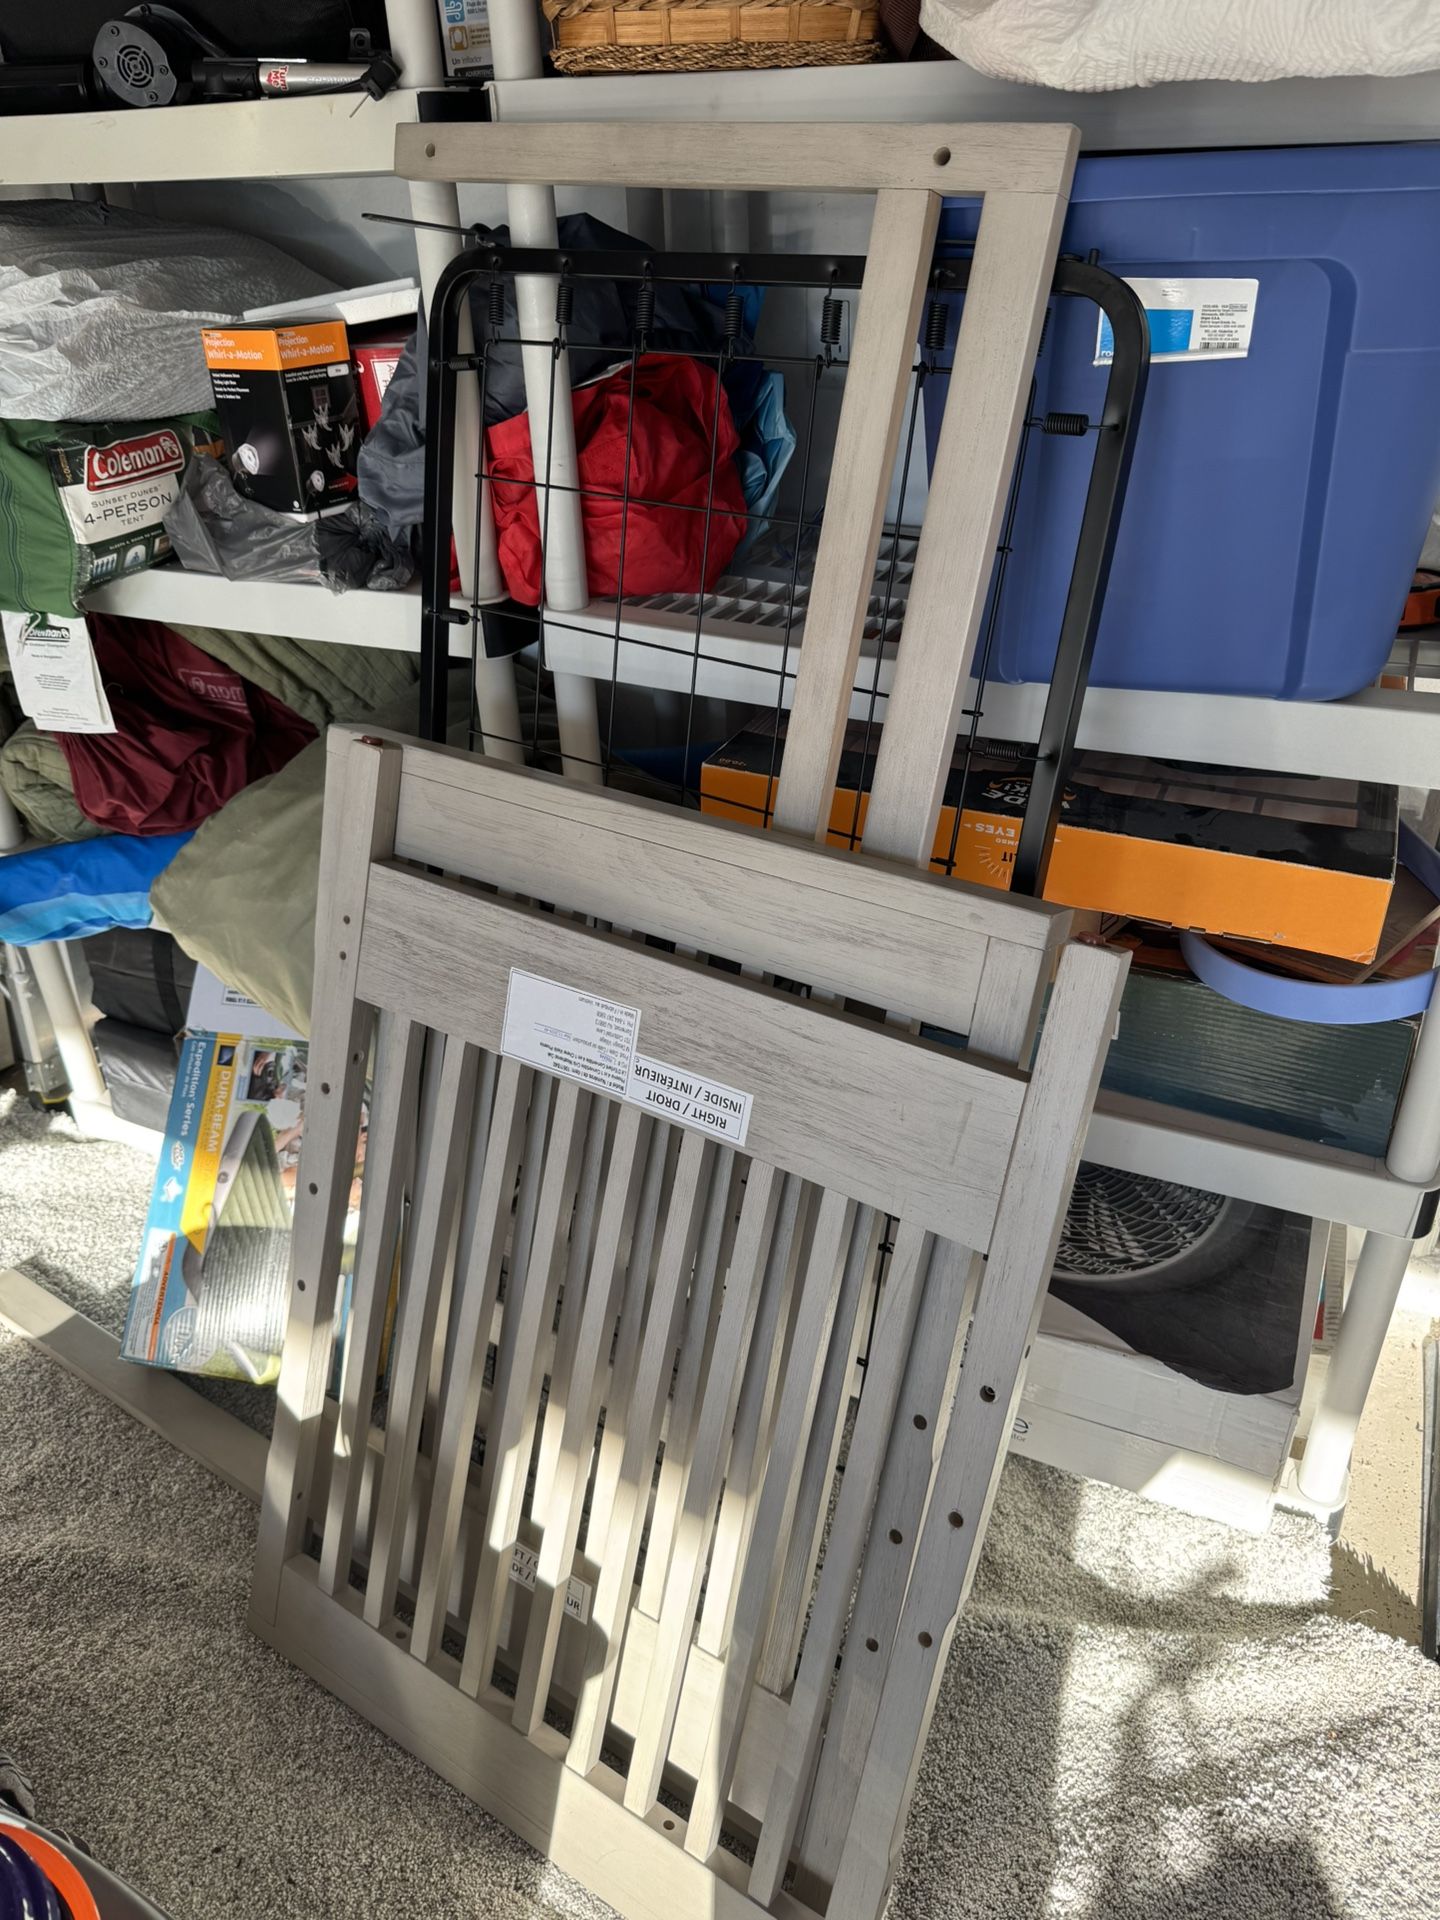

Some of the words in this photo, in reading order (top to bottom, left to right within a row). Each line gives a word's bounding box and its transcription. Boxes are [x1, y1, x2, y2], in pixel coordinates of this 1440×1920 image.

[278, 336, 309, 347] Projection
[93, 444, 164, 479] Coleman
[91, 494, 128, 508] SUNSET
[130, 486, 160, 499] DUNES
[84, 493, 172, 525] 4-PERSON
[121, 514, 145, 526] TENT
[975, 823, 1015, 837] EYES
[188, 1041, 207, 1098] Expedition
[634, 1064, 692, 1094] INTÉRIEUR
[645, 1090, 680, 1110] DROIT
[694, 1086, 701, 1098] /
[703, 1090, 741, 1113] INSIDE
[682, 1102, 689, 1114] /
[690, 1107, 727, 1128] RIGHT
[181, 1103, 195, 1136] Series
